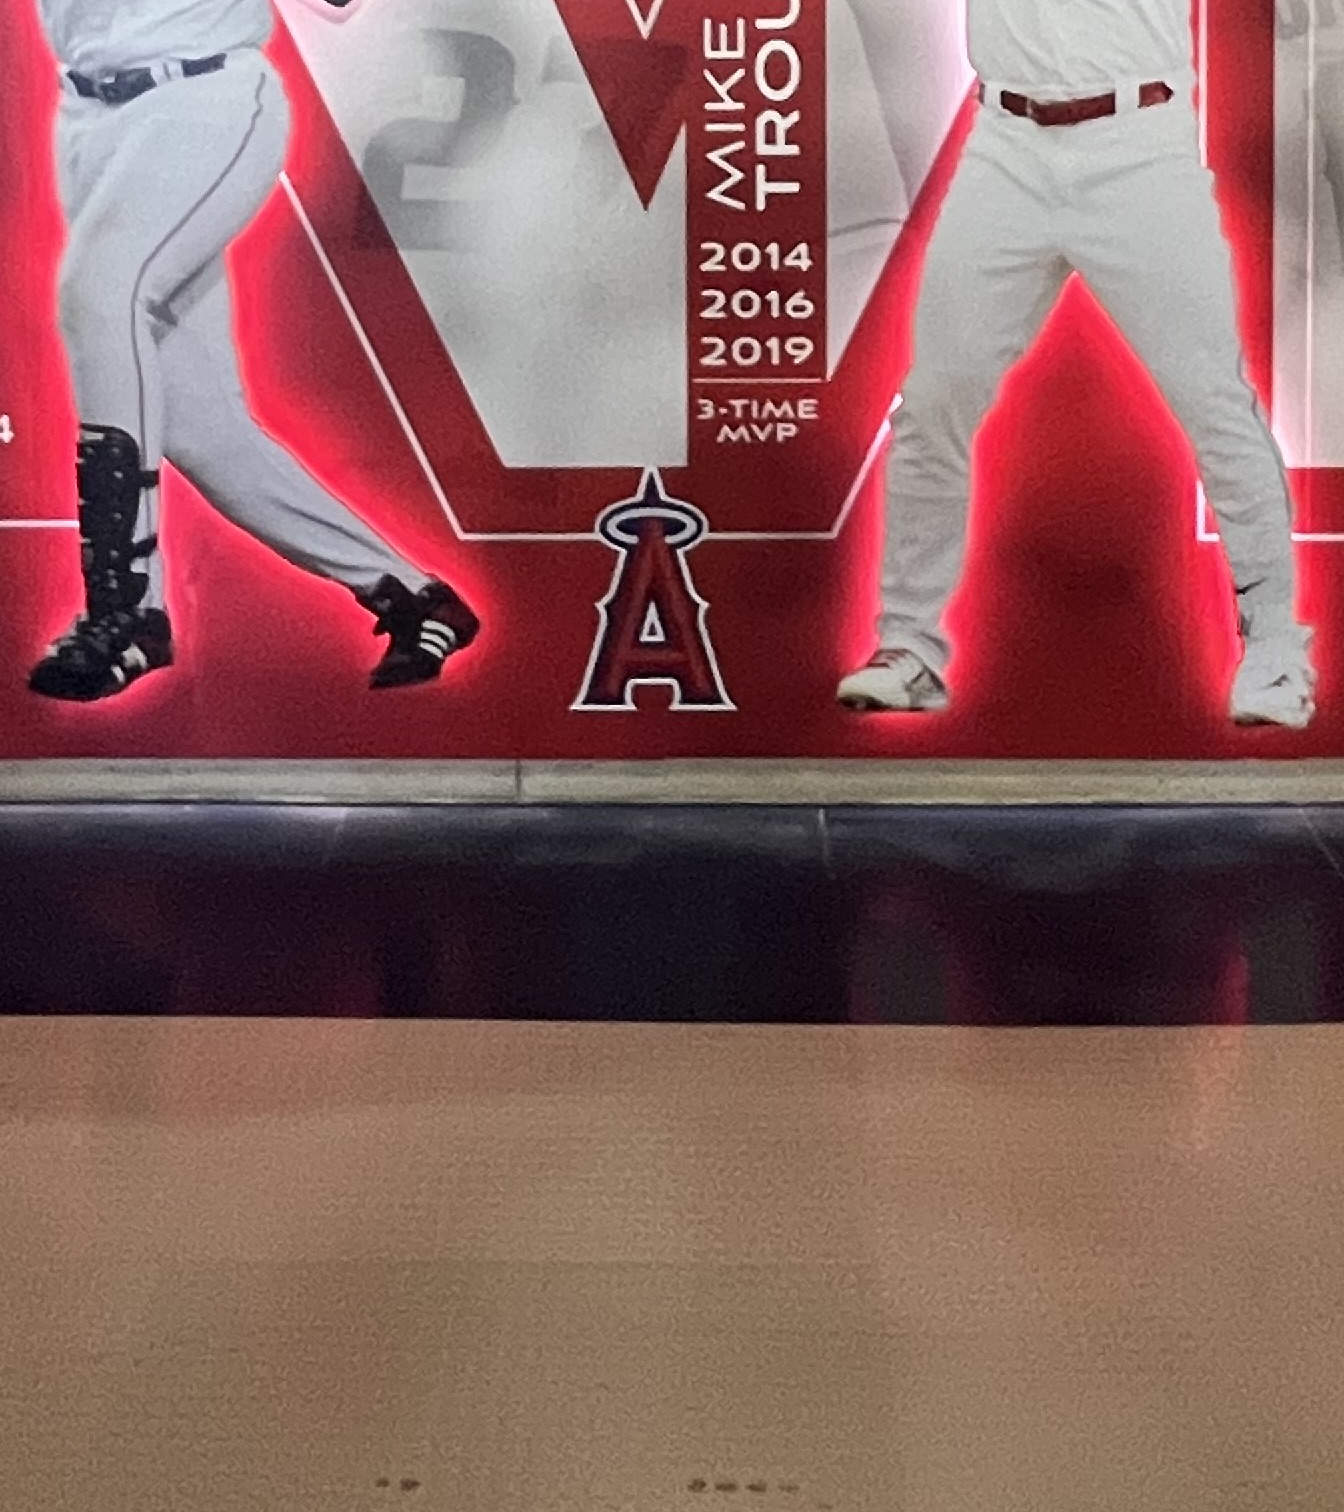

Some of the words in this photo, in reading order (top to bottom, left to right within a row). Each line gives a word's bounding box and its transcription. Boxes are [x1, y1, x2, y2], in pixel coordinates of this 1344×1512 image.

[703, 16, 747, 212] MIKE
[699, 241, 814, 272] 2014
[699, 289, 815, 320] 2016
[699, 336, 815, 367] 2019
[697, 397, 819, 420] 3-TIME
[716, 422, 799, 444] MVP
[569, 465, 738, 712] A
